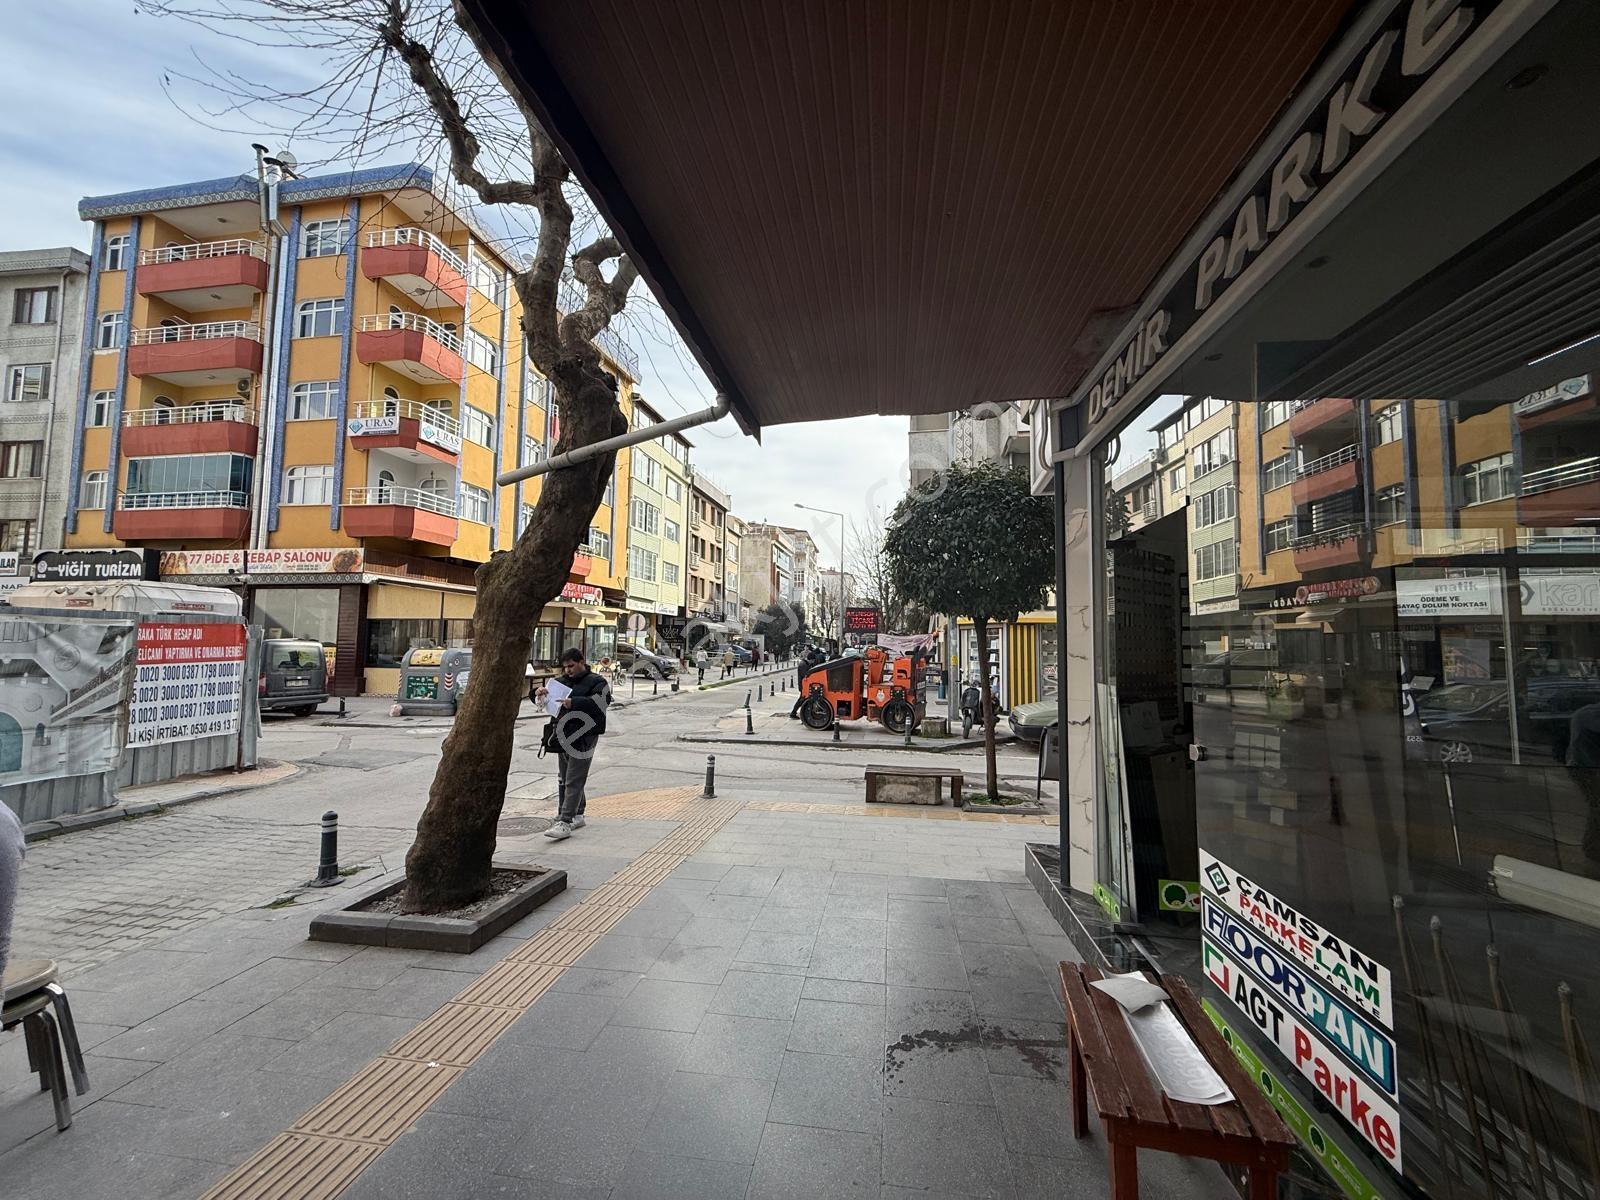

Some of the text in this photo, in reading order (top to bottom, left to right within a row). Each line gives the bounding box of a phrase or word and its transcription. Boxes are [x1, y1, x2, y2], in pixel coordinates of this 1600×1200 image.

[1087, 0, 1475, 425] DEMİR PARKE
[365, 418, 394, 427] URAS
[435, 430, 460, 445] URAS
[57, 560, 142, 577] YİĞİT TURİZM
[189, 553, 203, 564] 77
[232, 552, 240, 563] &
[283, 551, 332, 562] SALONU
[1539, 579, 1600, 606] kar
[156, 625, 172, 640] TÜRK
[174, 628, 192, 640] HESAP
[193, 628, 203, 640] ADI
[148, 645, 164, 660] CAMİ
[165, 647, 193, 659] YAPTIRMA
[194, 647, 202, 658] VE
[202, 646, 225, 658] ONARMA
[140, 666, 159, 682] 0020
[162, 665, 181, 681] 3000
[181, 664, 199, 680] 0387
[201, 663, 217, 679] 1798
[218, 663, 234, 677] 0000
[139, 686, 159, 703] 0020
[161, 685, 179, 701] 3000
[180, 684, 198, 699] 0387
[200, 682, 216, 698] 1798
[217, 681, 233, 696] 0000
[138, 707, 157, 723] 0020
[160, 705, 178, 721] 3000
[180, 703, 197, 719] 0387
[199, 701, 215, 717] 1798
[216, 700, 232, 715] 0000
[138, 725, 155, 744] KİŞİ
[157, 723, 189, 739] İRTİBAT:
[190, 722, 208, 735] 0530
[208, 720, 221, 732] 419
[223, 719, 231, 730] 13
[1236, 875, 1378, 983] ÇAMSAN
[1239, 894, 1380, 1008] PARKELAM
[1207, 908, 1385, 1081] FLOORPAN
[1313, 963, 1380, 1019] PARKE
[1235, 973, 1396, 1160] AGT Parke
